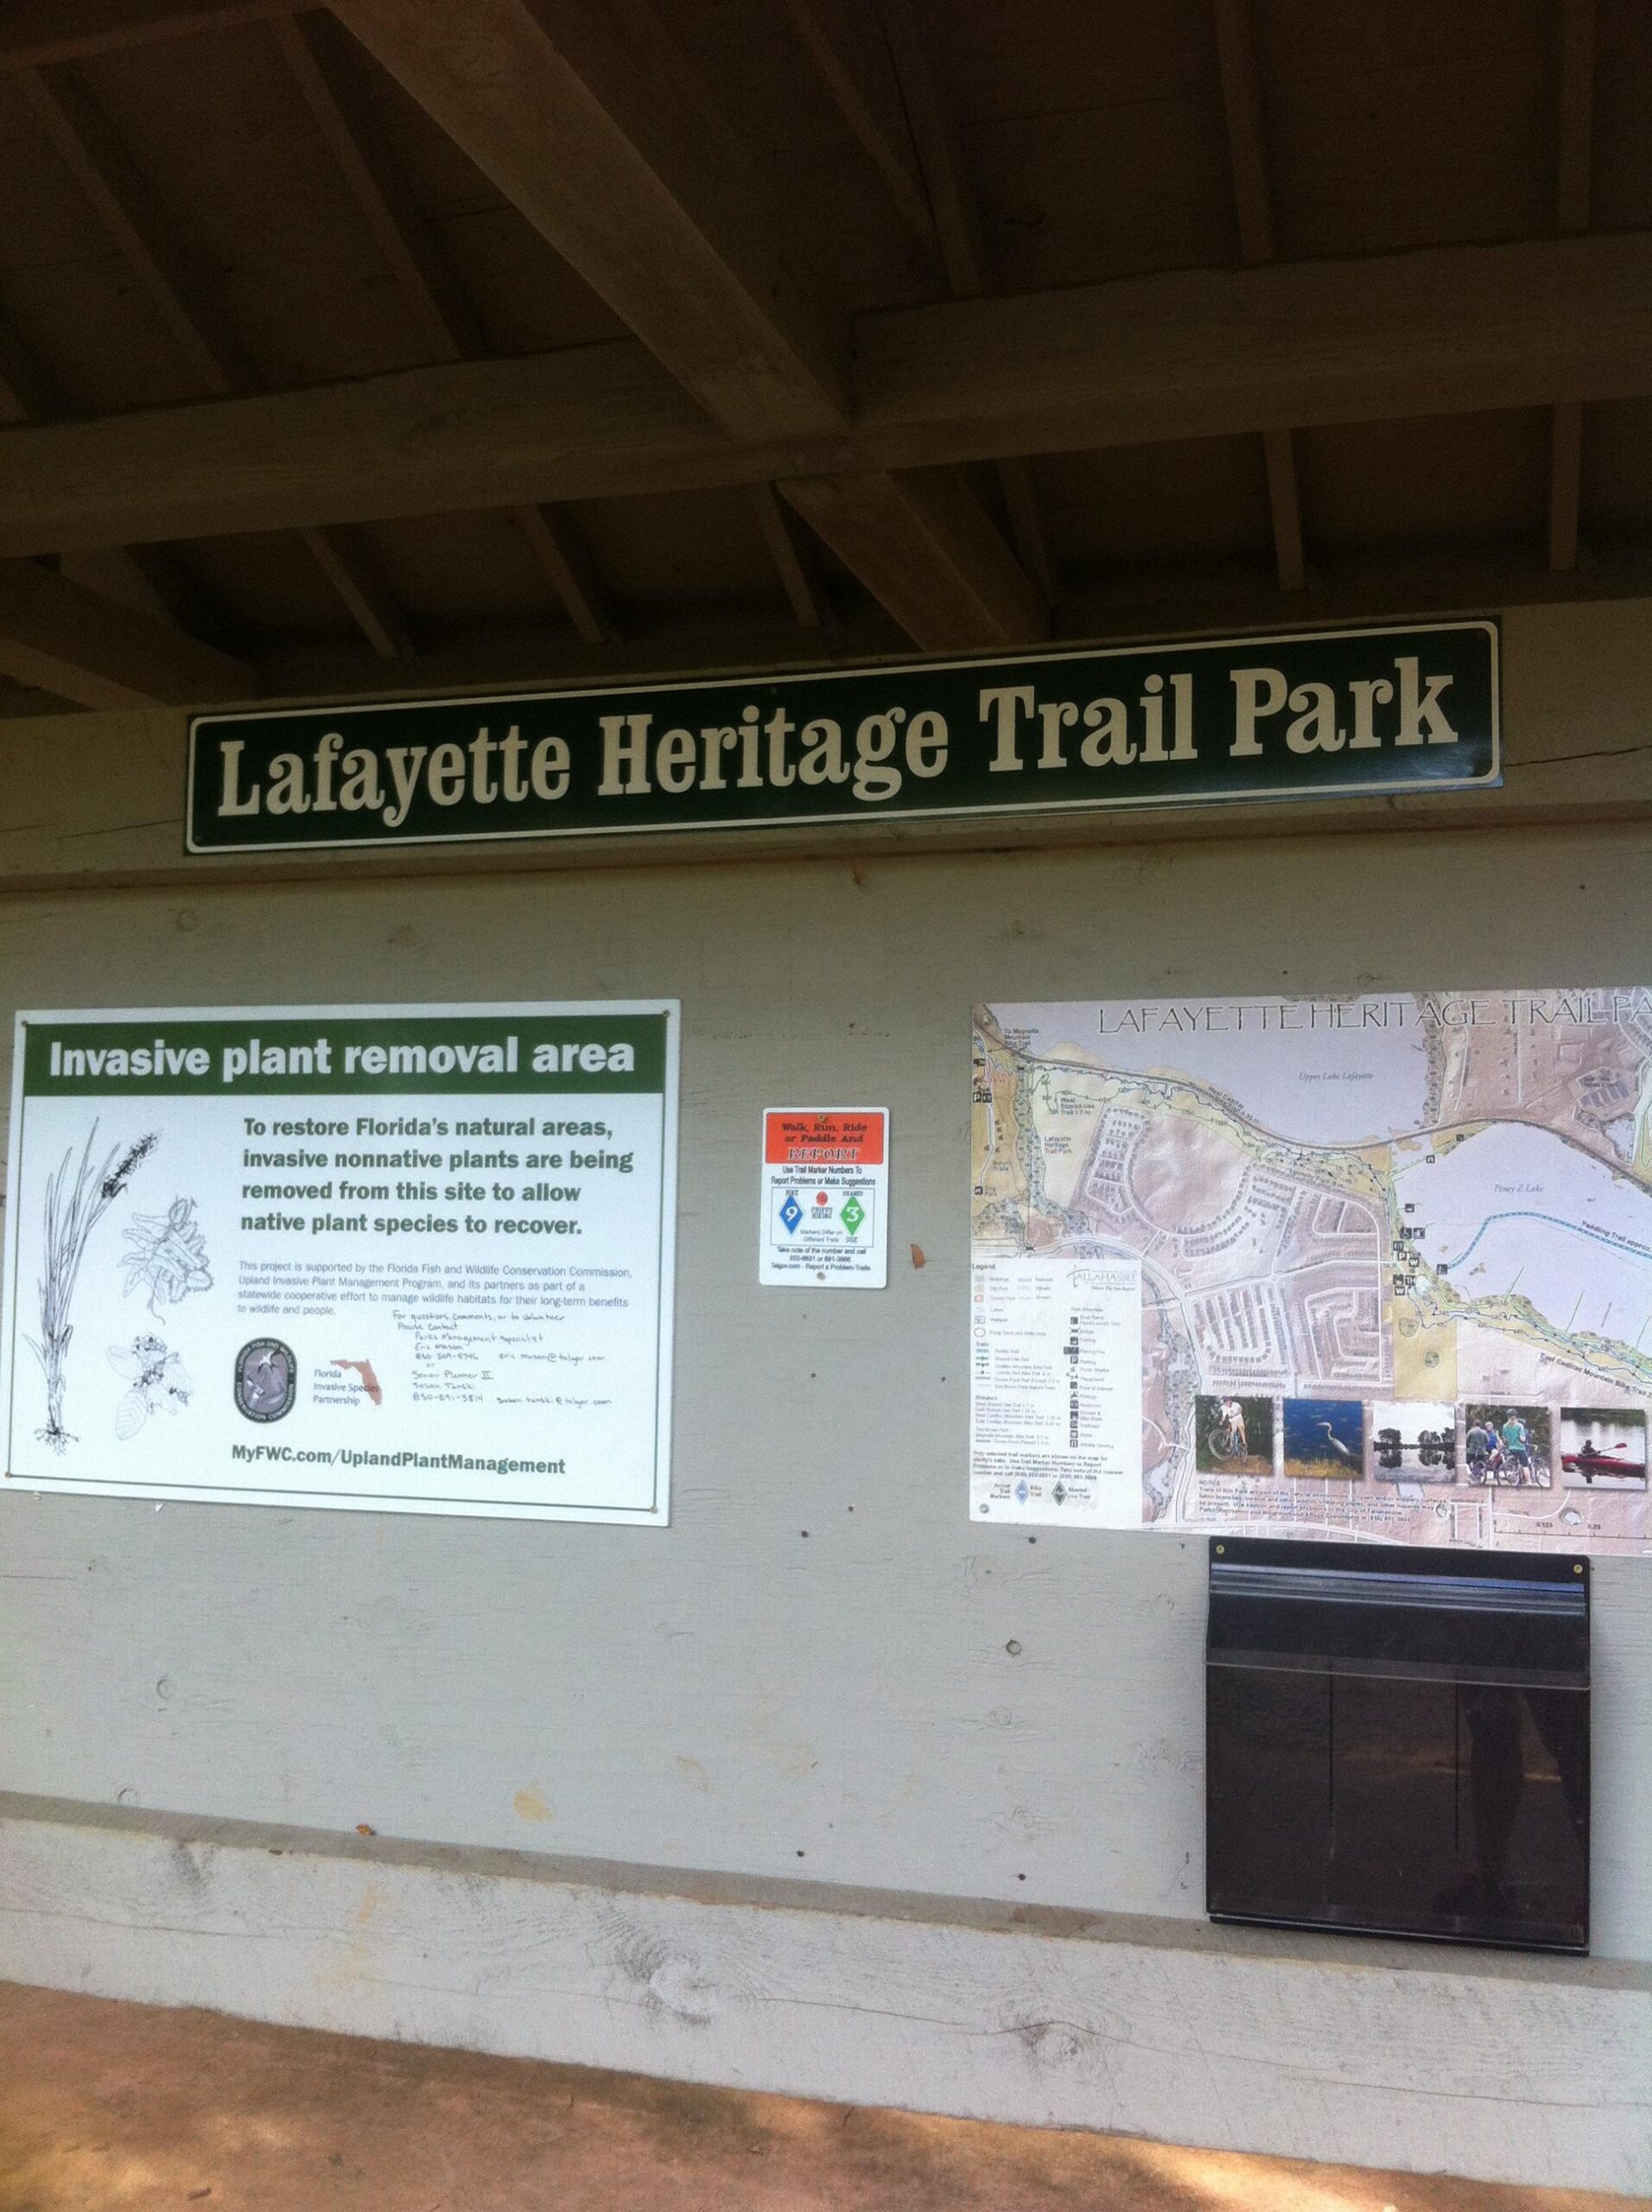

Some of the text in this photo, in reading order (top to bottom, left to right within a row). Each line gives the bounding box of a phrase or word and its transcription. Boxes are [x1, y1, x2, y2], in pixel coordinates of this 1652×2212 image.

[217, 656, 1459, 828] Lafayette Heritage Trail Park
[1099, 1004, 1303, 1033] LAFAYETTE
[1310, 999, 1496, 1029] HERITAGE
[1502, 997, 1606, 1025] TRAIL
[50, 1036, 635, 1083] Invasive plant removal area
[1299, 1071, 1374, 1082] Upper Lake Lafayette
[244, 1117, 613, 1141] To restore Florida's natural areas,
[782, 1122, 867, 1133] Walk, Run, Ride
[800, 1134, 836, 1142] Paddle
[842, 1134, 864, 1142] And
[244, 1149, 634, 1173] invasive nonnative plants are being
[788, 1147, 861, 1160] REPORT
[808, 1166, 828, 1174] Marker
[829, 1166, 855, 1174] Numbers
[855, 1166, 862, 1174] To
[771, 1176, 789, 1185] Report
[790, 1176, 816, 1185] Problems
[842, 1177, 876, 1187] Suggestions
[1494, 1184, 1544, 1193] Piney Z Lake
[242, 1180, 581, 1201] removed from this site to allow
[785, 1206, 798, 1222] 9
[847, 1206, 860, 1222] 3
[241, 1212, 582, 1236] native plant species to recover.
[1581, 1220, 1611, 1236] Paddling
[1611, 1231, 1627, 1243] Trail
[239, 1261, 632, 1278] This project is supported by the Florida Fish and Wildlife Conservation Commission,
[238, 1275, 585, 1293] Upland Invasive Plant Management Program, and its partners as part of a
[1066, 1268, 1138, 1288] TALLAHASSEE
[238, 1290, 629, 1307] statewide cooperative effort to manage wildlife habitats for their long-term benefits
[238, 1304, 336, 1316] to wildlife and people.
[393, 1310, 406, 1319] For
[266, 1340, 278, 1349] AND
[314, 1369, 341, 1378] Florida
[444, 1370, 478, 1379] Planner
[1540, 1353, 1555, 1363] East
[1555, 1357, 1584, 1373] Cadillac
[1584, 1368, 1613, 1384] Mountain
[314, 1382, 379, 1393] Invasive Species
[313, 1395, 360, 1406] Partnership
[232, 1444, 566, 1475] MyFWC.com/UplandPlantManagement
